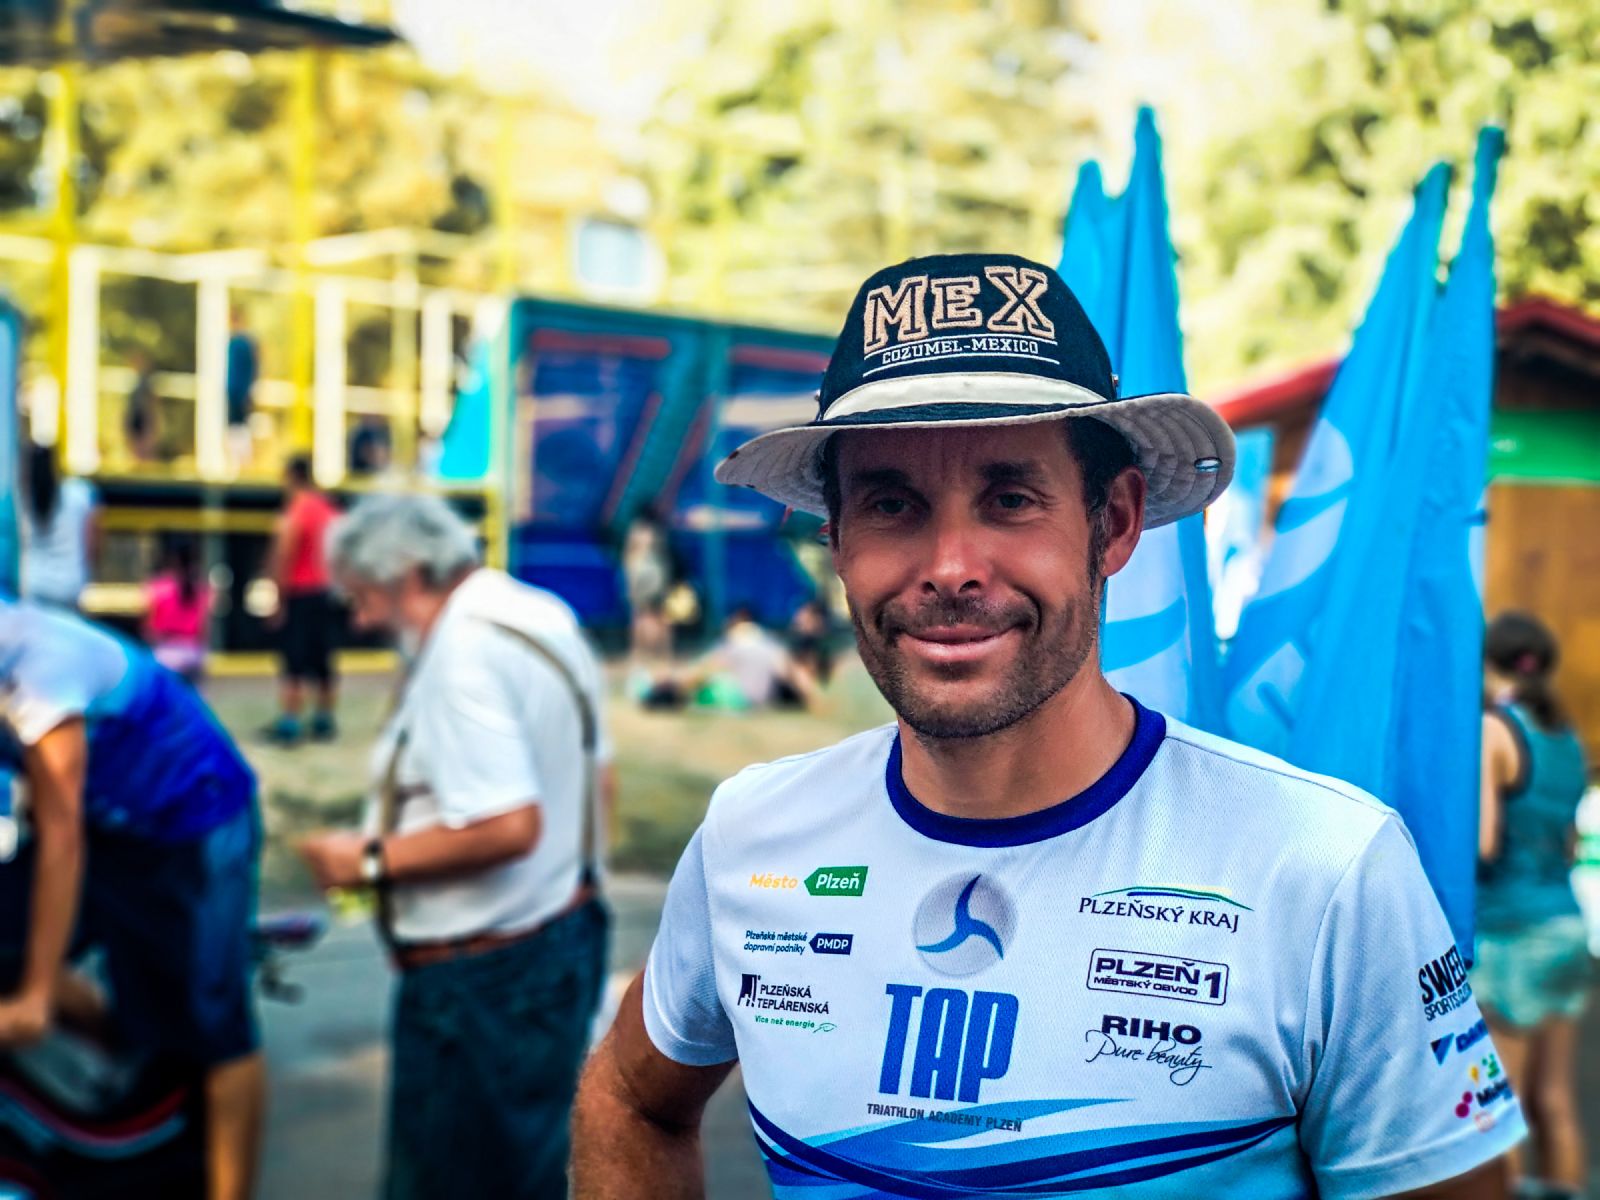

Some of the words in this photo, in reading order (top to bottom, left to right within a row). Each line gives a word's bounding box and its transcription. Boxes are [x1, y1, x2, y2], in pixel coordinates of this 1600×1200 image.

[864, 265, 1055, 354] MEX
[882, 337, 1039, 365] COZUMEL-MEXICO
[750, 873, 798, 889] Město
[815, 872, 860, 889] Plzeň
[1078, 897, 1184, 923] PLZEŇSKÝ
[1189, 910, 1239, 933] KRAJ
[745, 930, 776, 941] Plzeňské
[777, 931, 808, 942] městské
[816, 938, 849, 950] PMDP
[744, 942, 775, 953] dopravní
[775, 944, 805, 956] podniky
[1094, 975, 1152, 989] MĚSTSKÝ
[1153, 983, 1198, 996] OBVOD
[1096, 957, 1200, 985] PLZEŇ
[1204, 972, 1222, 998] 1
[760, 984, 812, 999] PLZEŇSKÁ
[757, 998, 829, 1014] TEPLÁRENSKÁ
[785, 1020, 815, 1029] energie
[1101, 1014, 1202, 1045] RIHO
[879, 983, 1020, 1104] TAP
[1085, 1029, 1144, 1063] Pure
[1147, 1036, 1212, 1086] beauty
[867, 1103, 925, 1120] TRIATHLON
[928, 1110, 982, 1127] ACADEMY
[986, 1115, 1023, 1132] PLZEŇ
